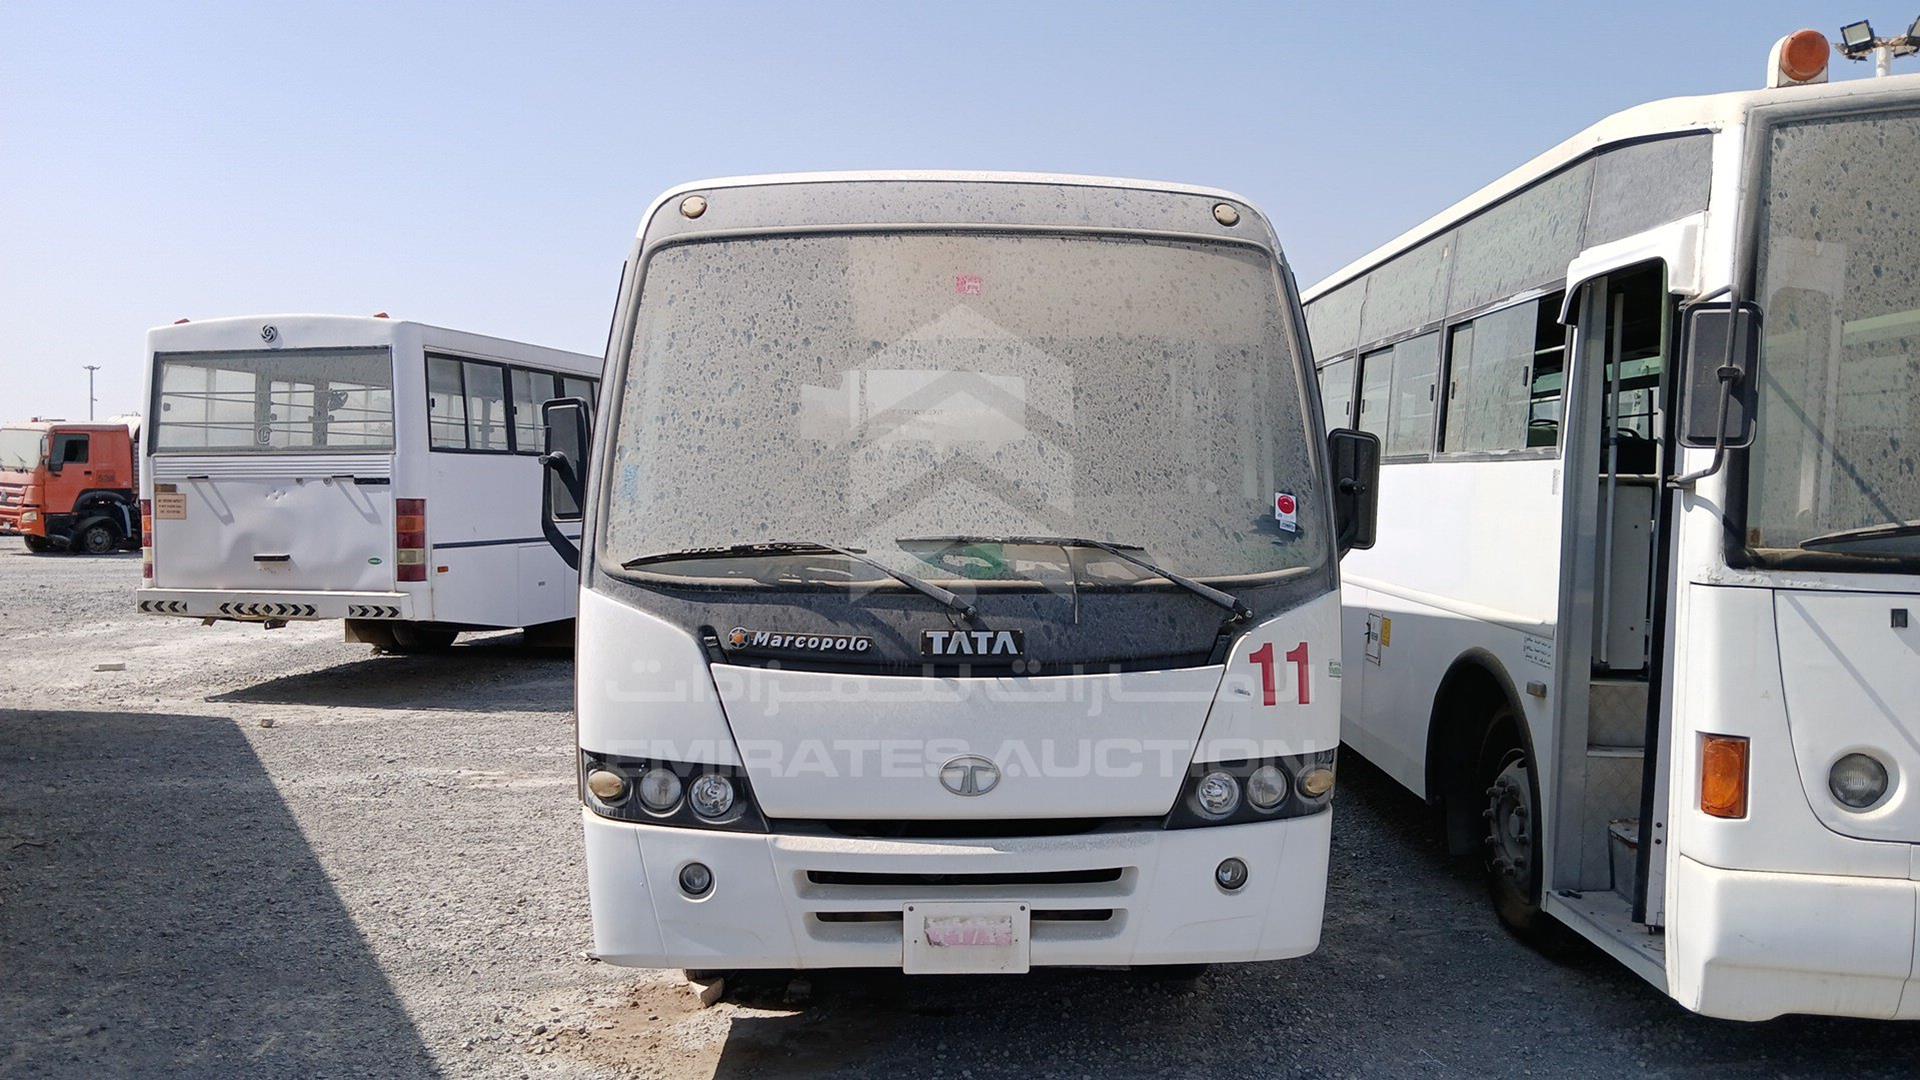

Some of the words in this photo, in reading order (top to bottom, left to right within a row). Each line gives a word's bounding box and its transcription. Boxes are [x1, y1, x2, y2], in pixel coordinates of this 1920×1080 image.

[752, 630, 869, 653] Marcopolo
[926, 631, 1019, 655] TATA
[1249, 642, 1310, 706] 11
